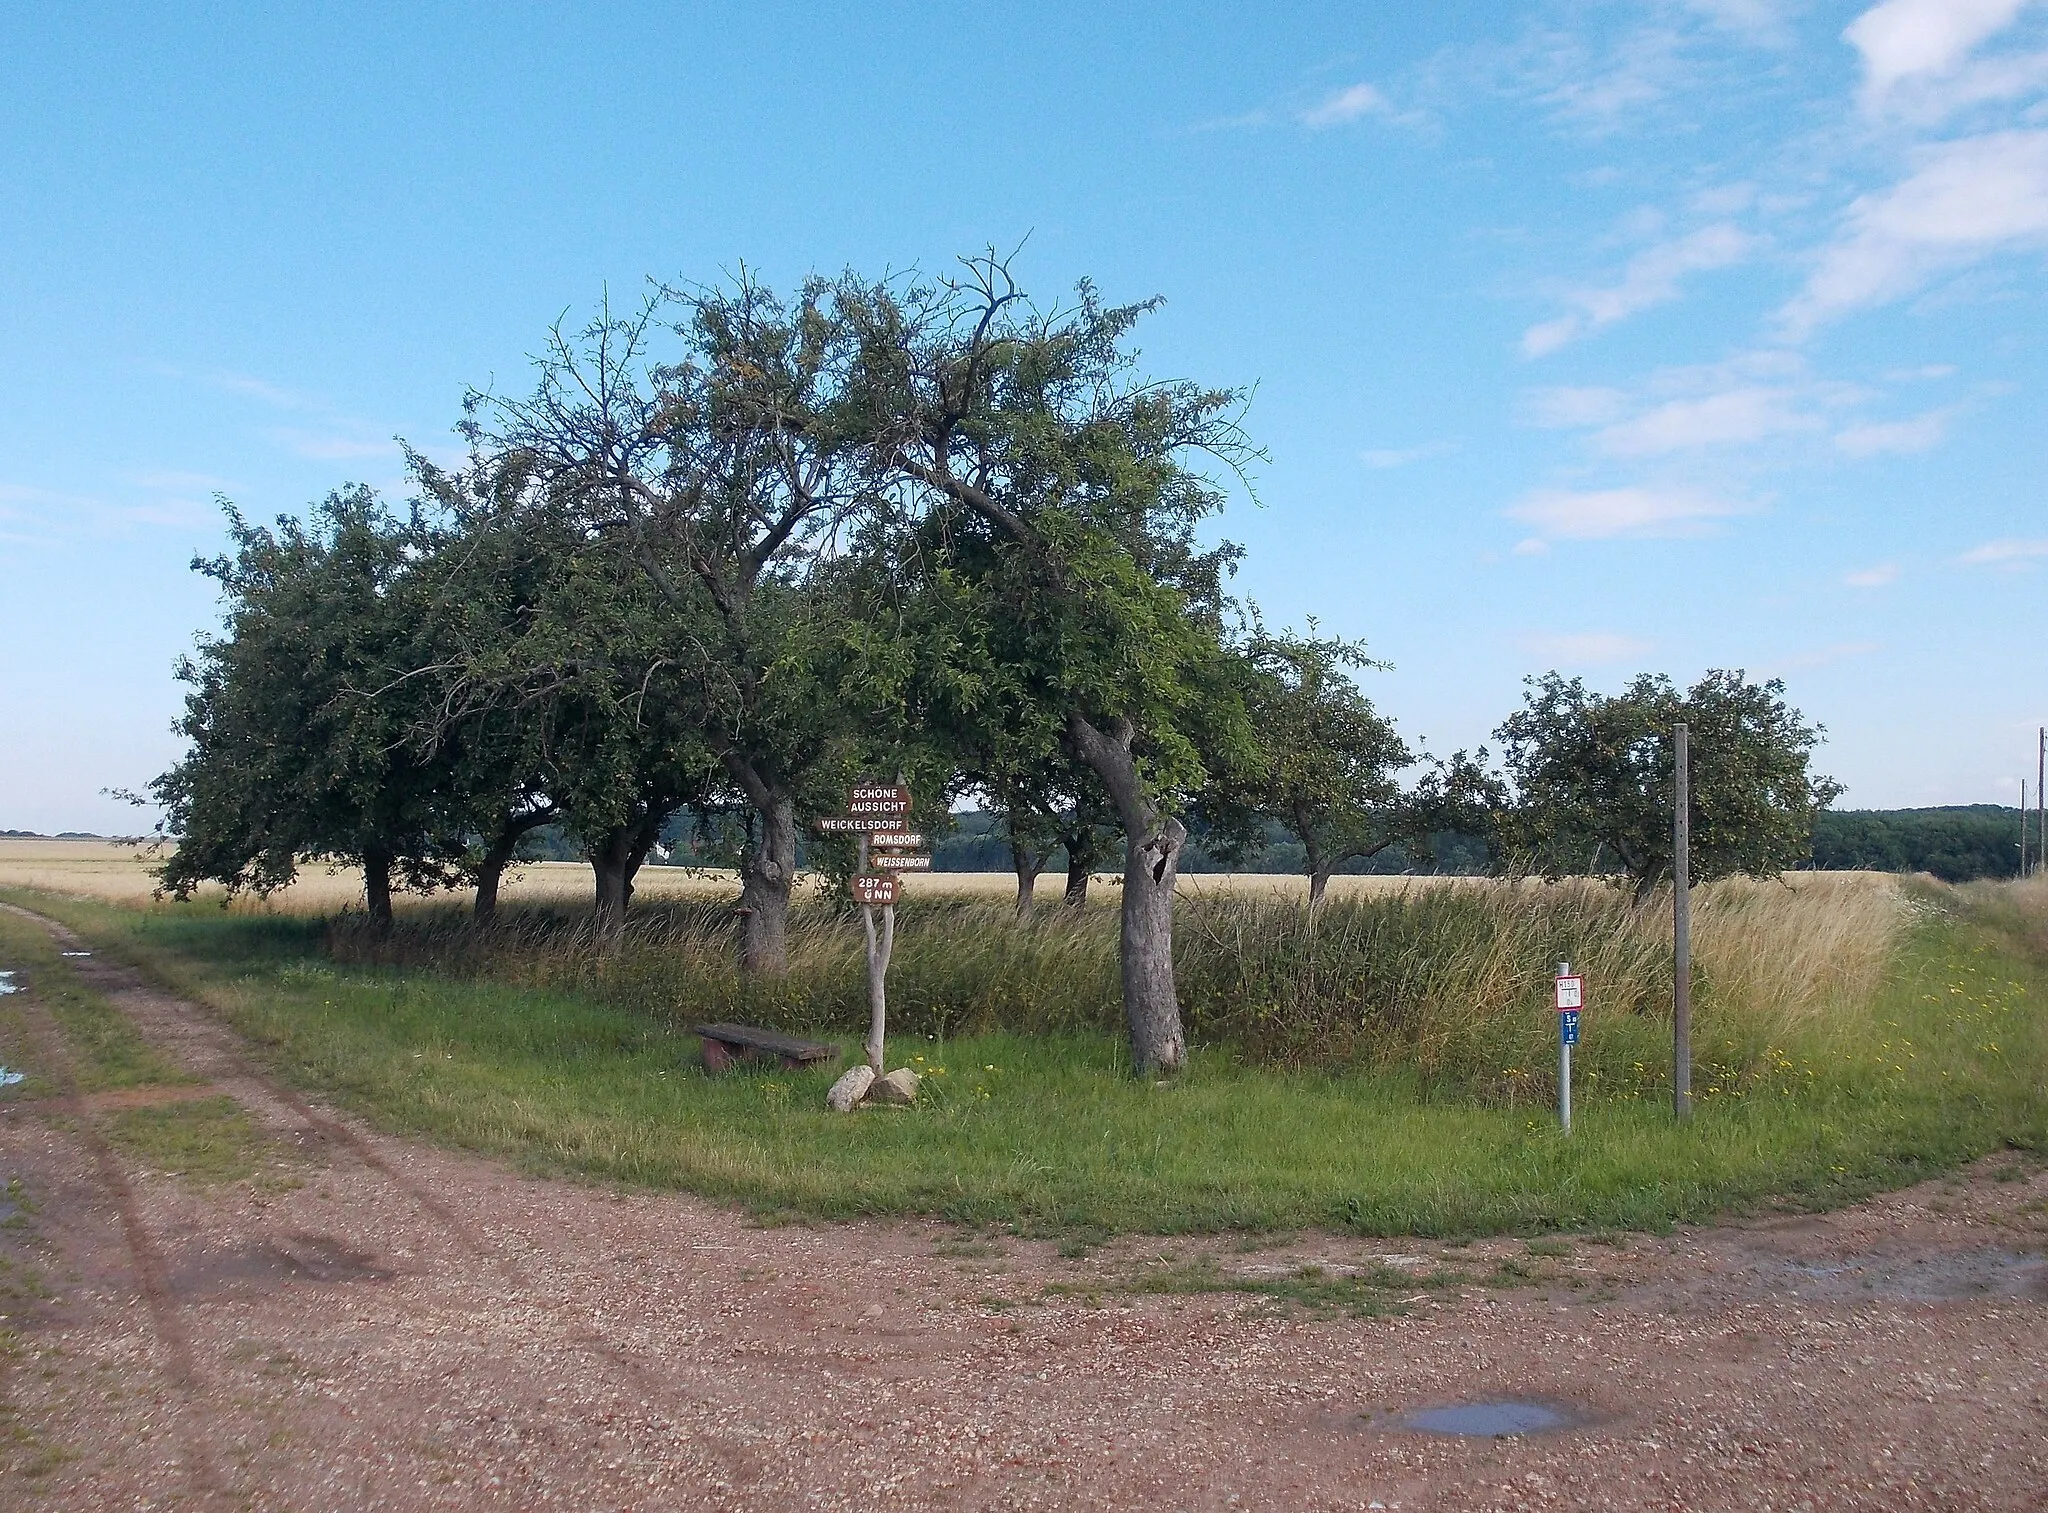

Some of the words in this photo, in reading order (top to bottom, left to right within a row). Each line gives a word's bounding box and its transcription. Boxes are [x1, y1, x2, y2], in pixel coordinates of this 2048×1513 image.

[853, 786, 898, 799] SCHÖNE
[850, 801, 907, 812] AUSSICHT
[821, 820, 903, 830] WEICKELSDORF
[873, 834, 922, 845] ROMSDORF
[876, 857, 931, 867] WEISSENBORN
[858, 878, 880, 888] 287
[882, 881, 893, 889] m
[874, 890, 892, 900] NN
